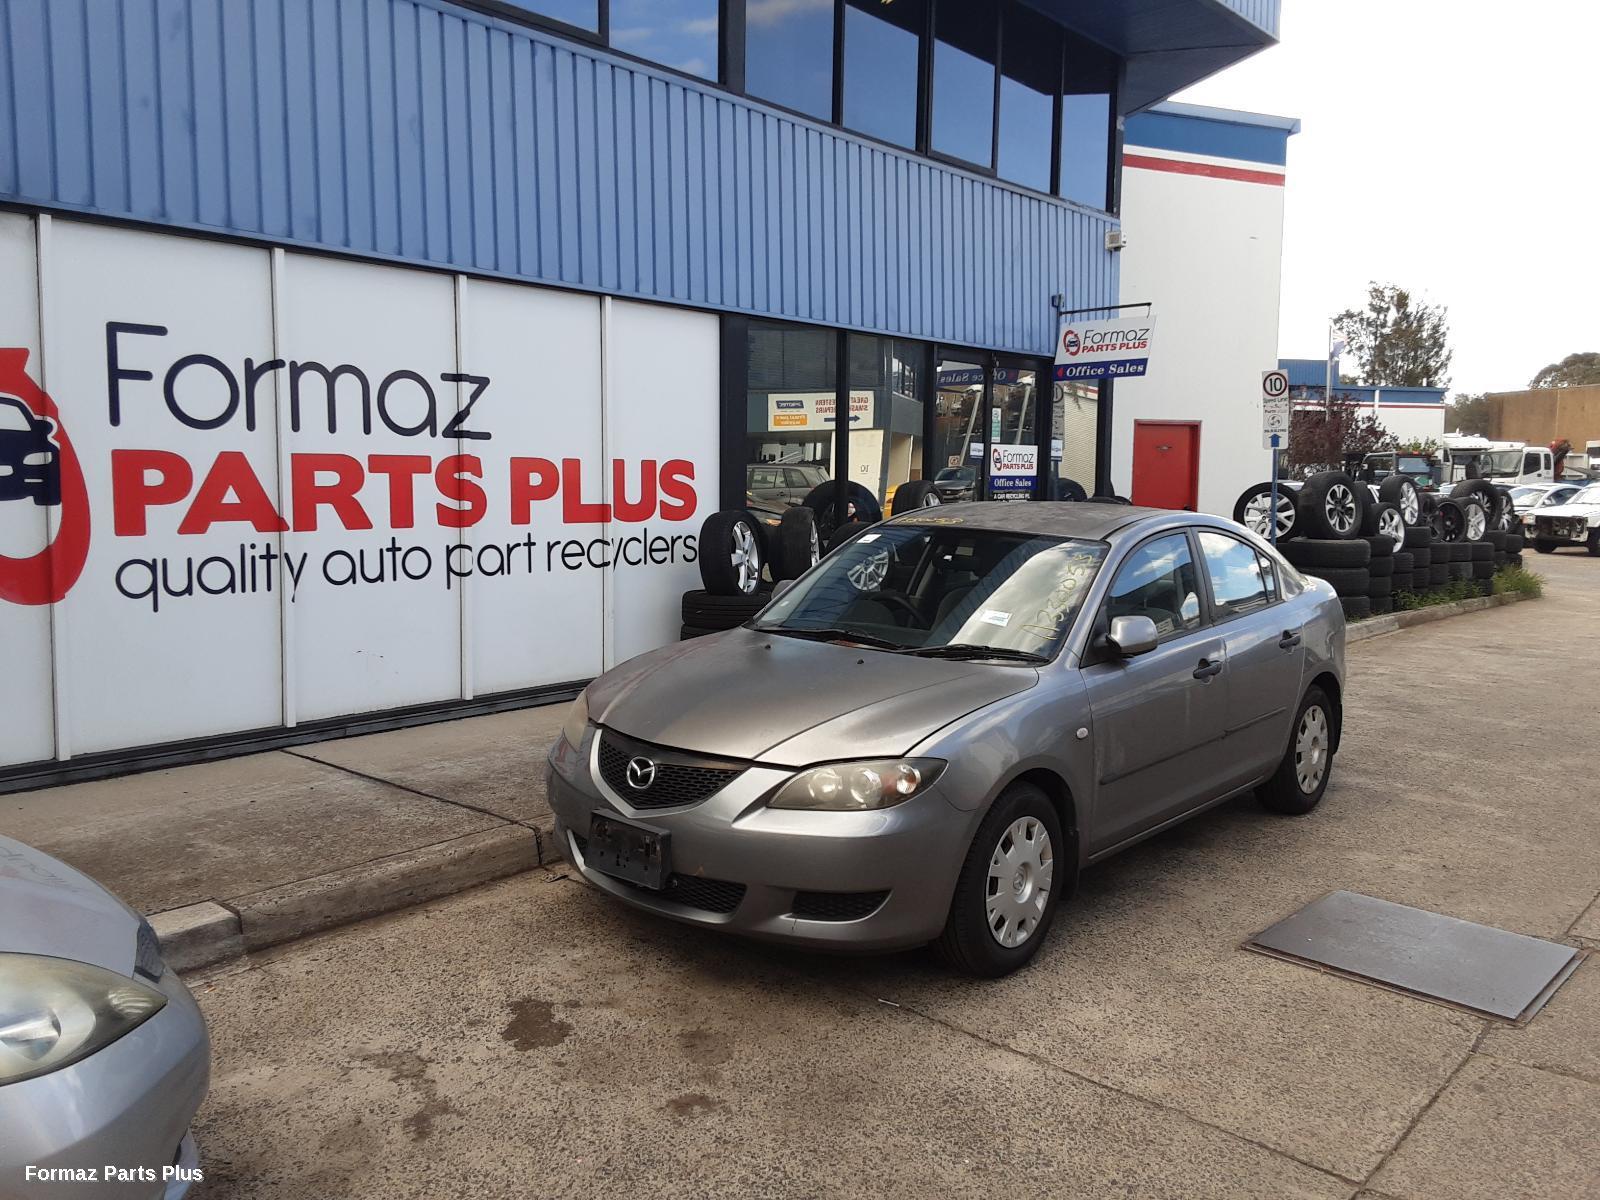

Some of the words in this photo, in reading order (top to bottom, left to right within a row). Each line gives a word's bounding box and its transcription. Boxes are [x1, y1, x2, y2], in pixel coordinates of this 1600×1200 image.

[1083, 328, 1150, 345] Formaz
[1082, 343, 1117, 353] PARTS
[1119, 340, 1148, 350] PLUS
[1066, 366, 1105, 377] Office
[1109, 364, 1144, 374] Sales
[105, 320, 492, 442] Formaz
[1268, 377, 1283, 392] 10
[1002, 449, 1034, 464] Formaz
[994, 478, 1014, 487] Office
[1014, 478, 1032, 487] Sales
[112, 449, 490, 537] PARTS
[509, 457, 698, 525] PLUS
[115, 541, 308, 613] quality
[322, 537, 432, 588] auto
[445, 533, 537, 590] part
[544, 527, 699, 574] recyclers
